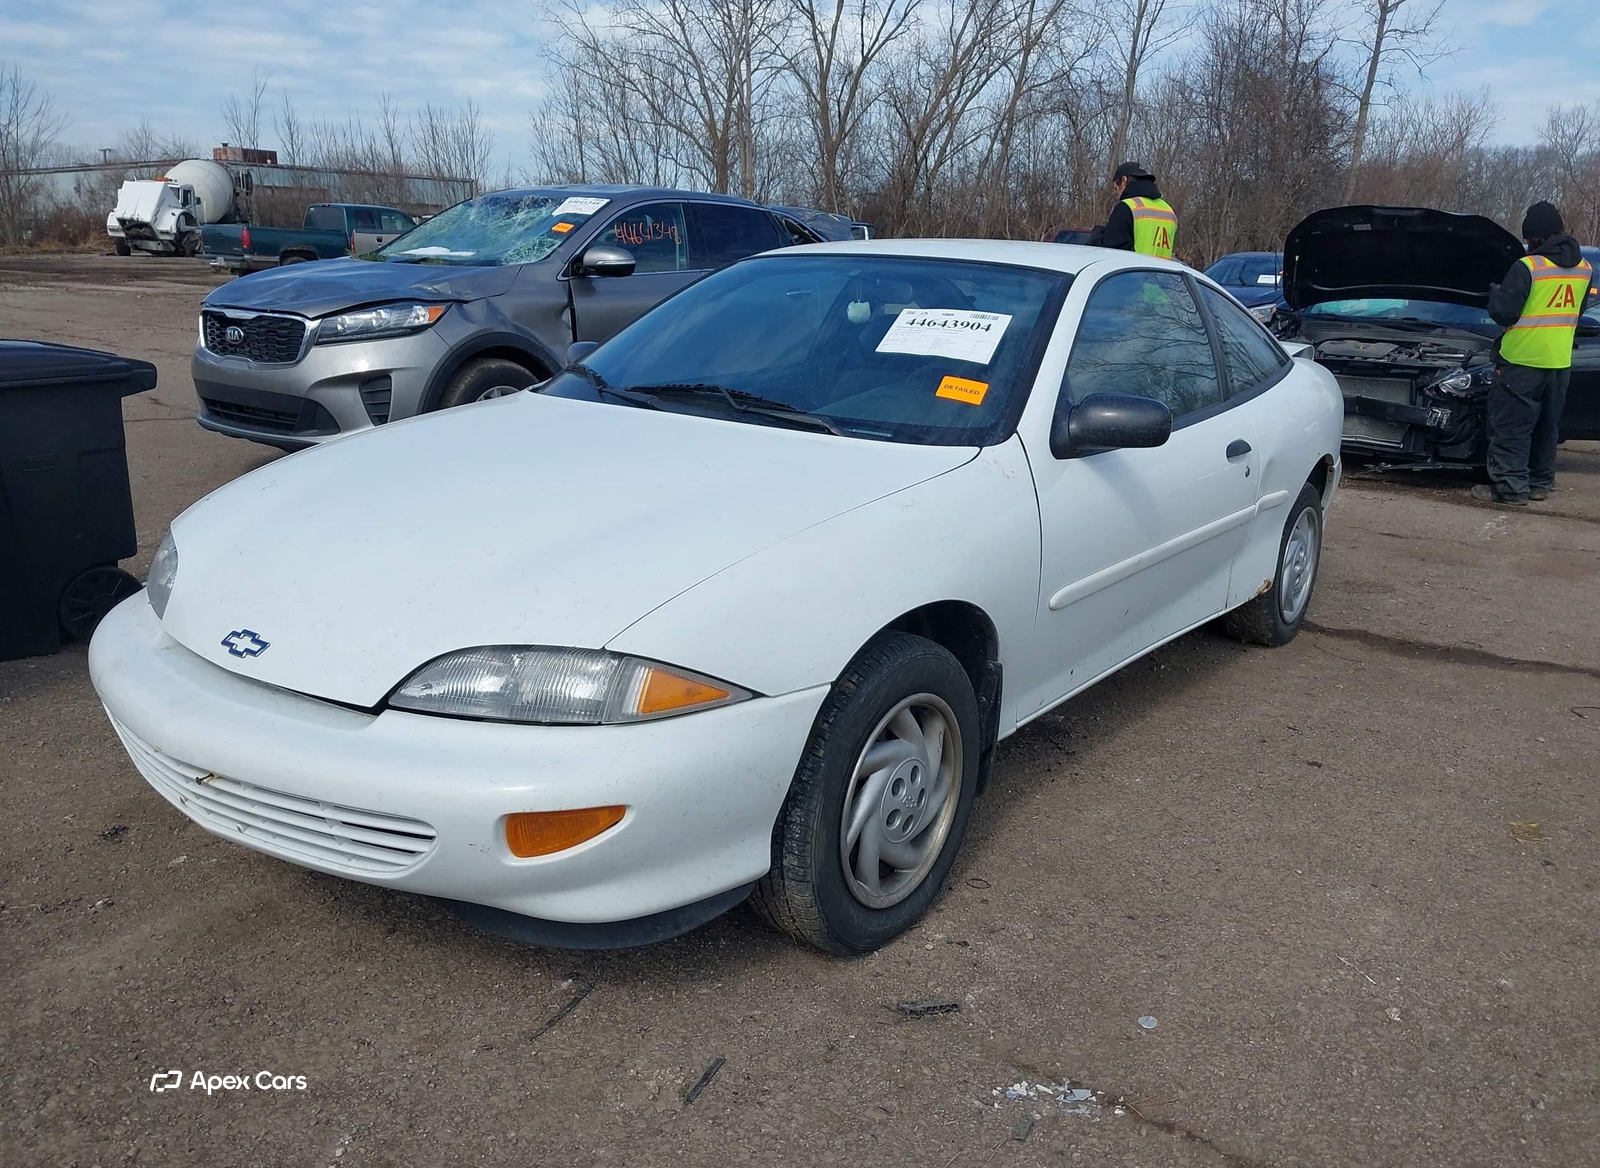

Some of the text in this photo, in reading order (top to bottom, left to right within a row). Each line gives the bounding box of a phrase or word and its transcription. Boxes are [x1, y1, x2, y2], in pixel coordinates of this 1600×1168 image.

[614, 221, 682, 244] 44641348
[905, 318, 992, 332] 44643904
[227, 329, 240, 341] KIA
[943, 383, 981, 396] DETAILED
